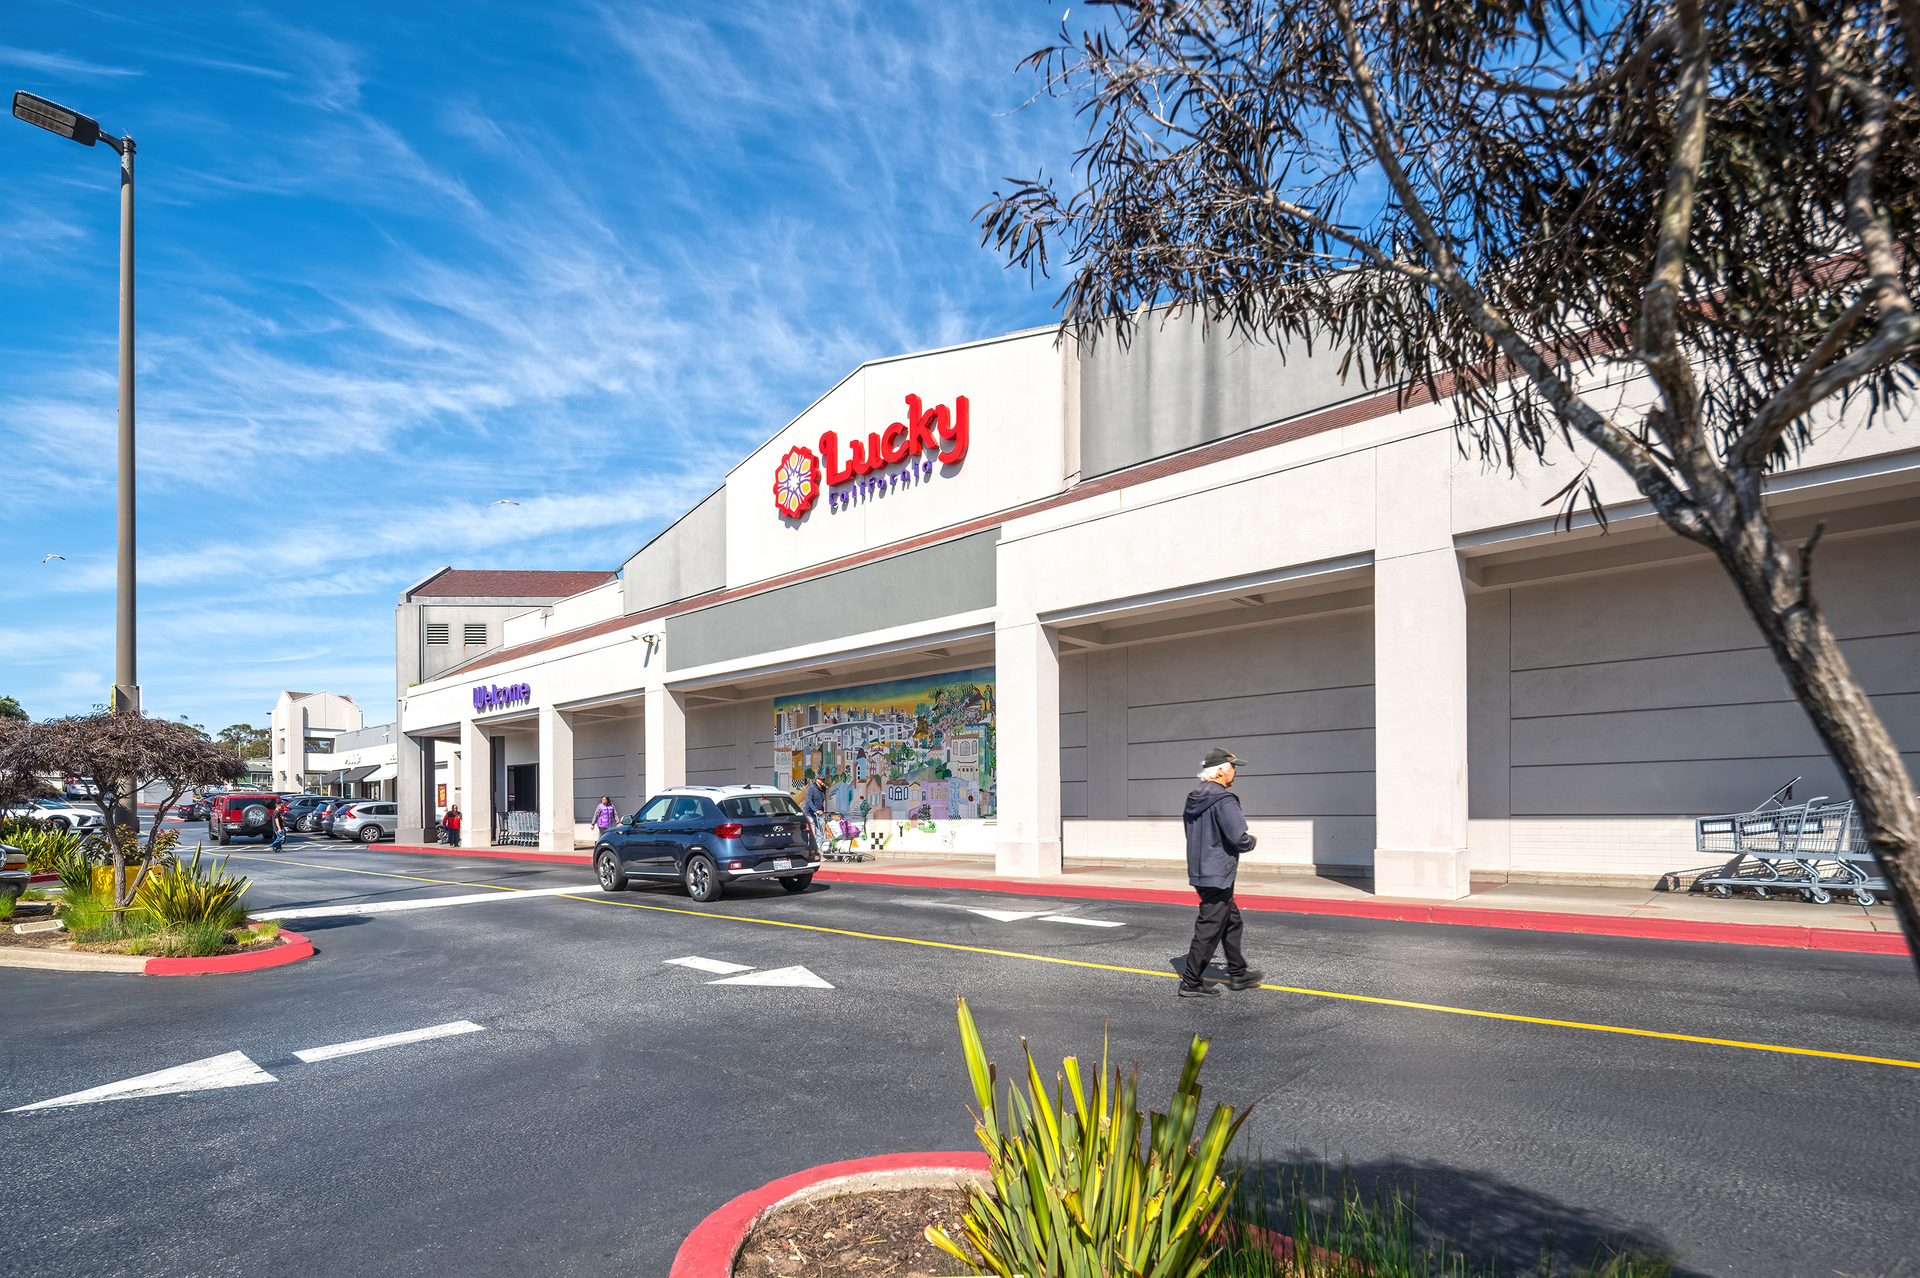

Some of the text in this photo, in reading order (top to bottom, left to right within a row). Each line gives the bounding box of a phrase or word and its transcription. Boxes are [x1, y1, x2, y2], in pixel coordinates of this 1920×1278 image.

[819, 393, 969, 487] Lucky
[828, 460, 933, 506] California
[473, 682, 531, 709] Welcome
